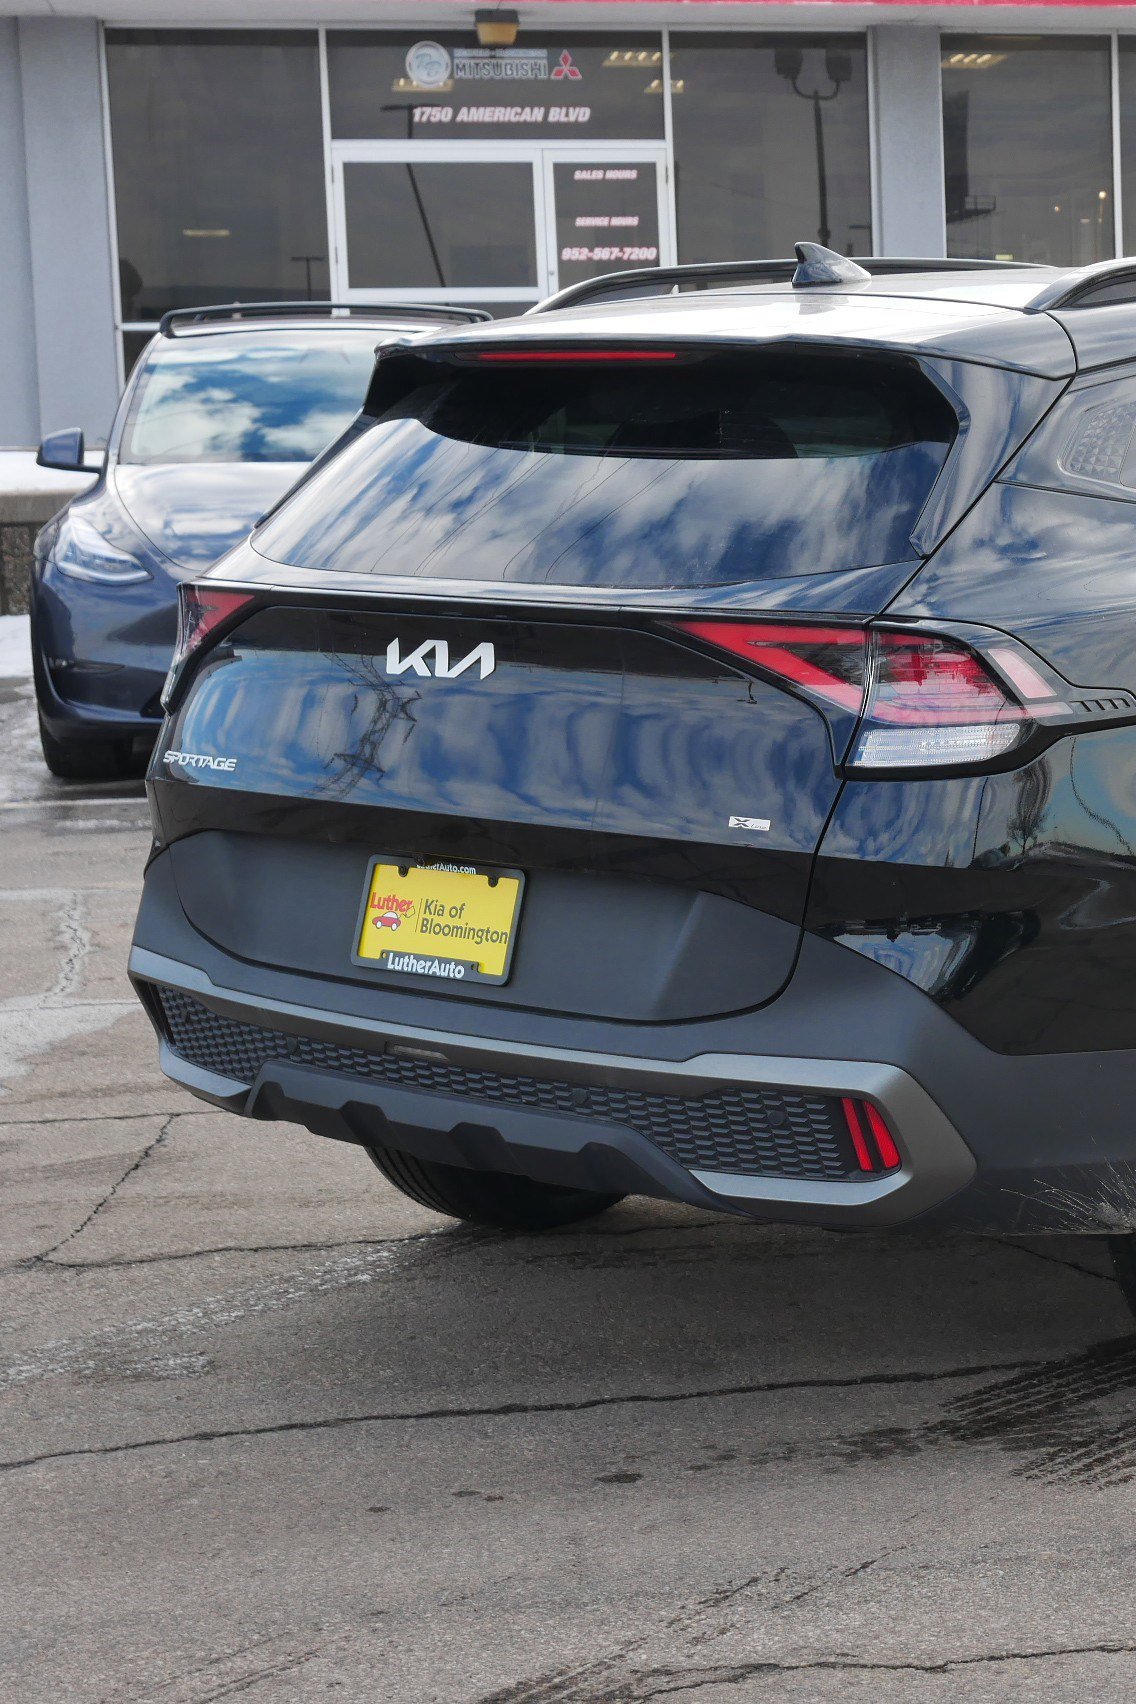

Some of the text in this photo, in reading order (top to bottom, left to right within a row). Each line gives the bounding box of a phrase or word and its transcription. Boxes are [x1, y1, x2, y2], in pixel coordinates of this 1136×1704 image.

[454, 60, 548, 78] MITSUBISHI
[413, 107, 591, 122] 1750 AMERICAN BLVD
[574, 169, 637, 180] SALES HOURS
[386, 637, 495, 680] KIA
[163, 750, 237, 771] SPORTAGE
[370, 891, 414, 912] Luther
[423, 898, 466, 920] Kia of
[420, 917, 509, 945] Bloomington
[387, 952, 465, 979] LutherAuto
